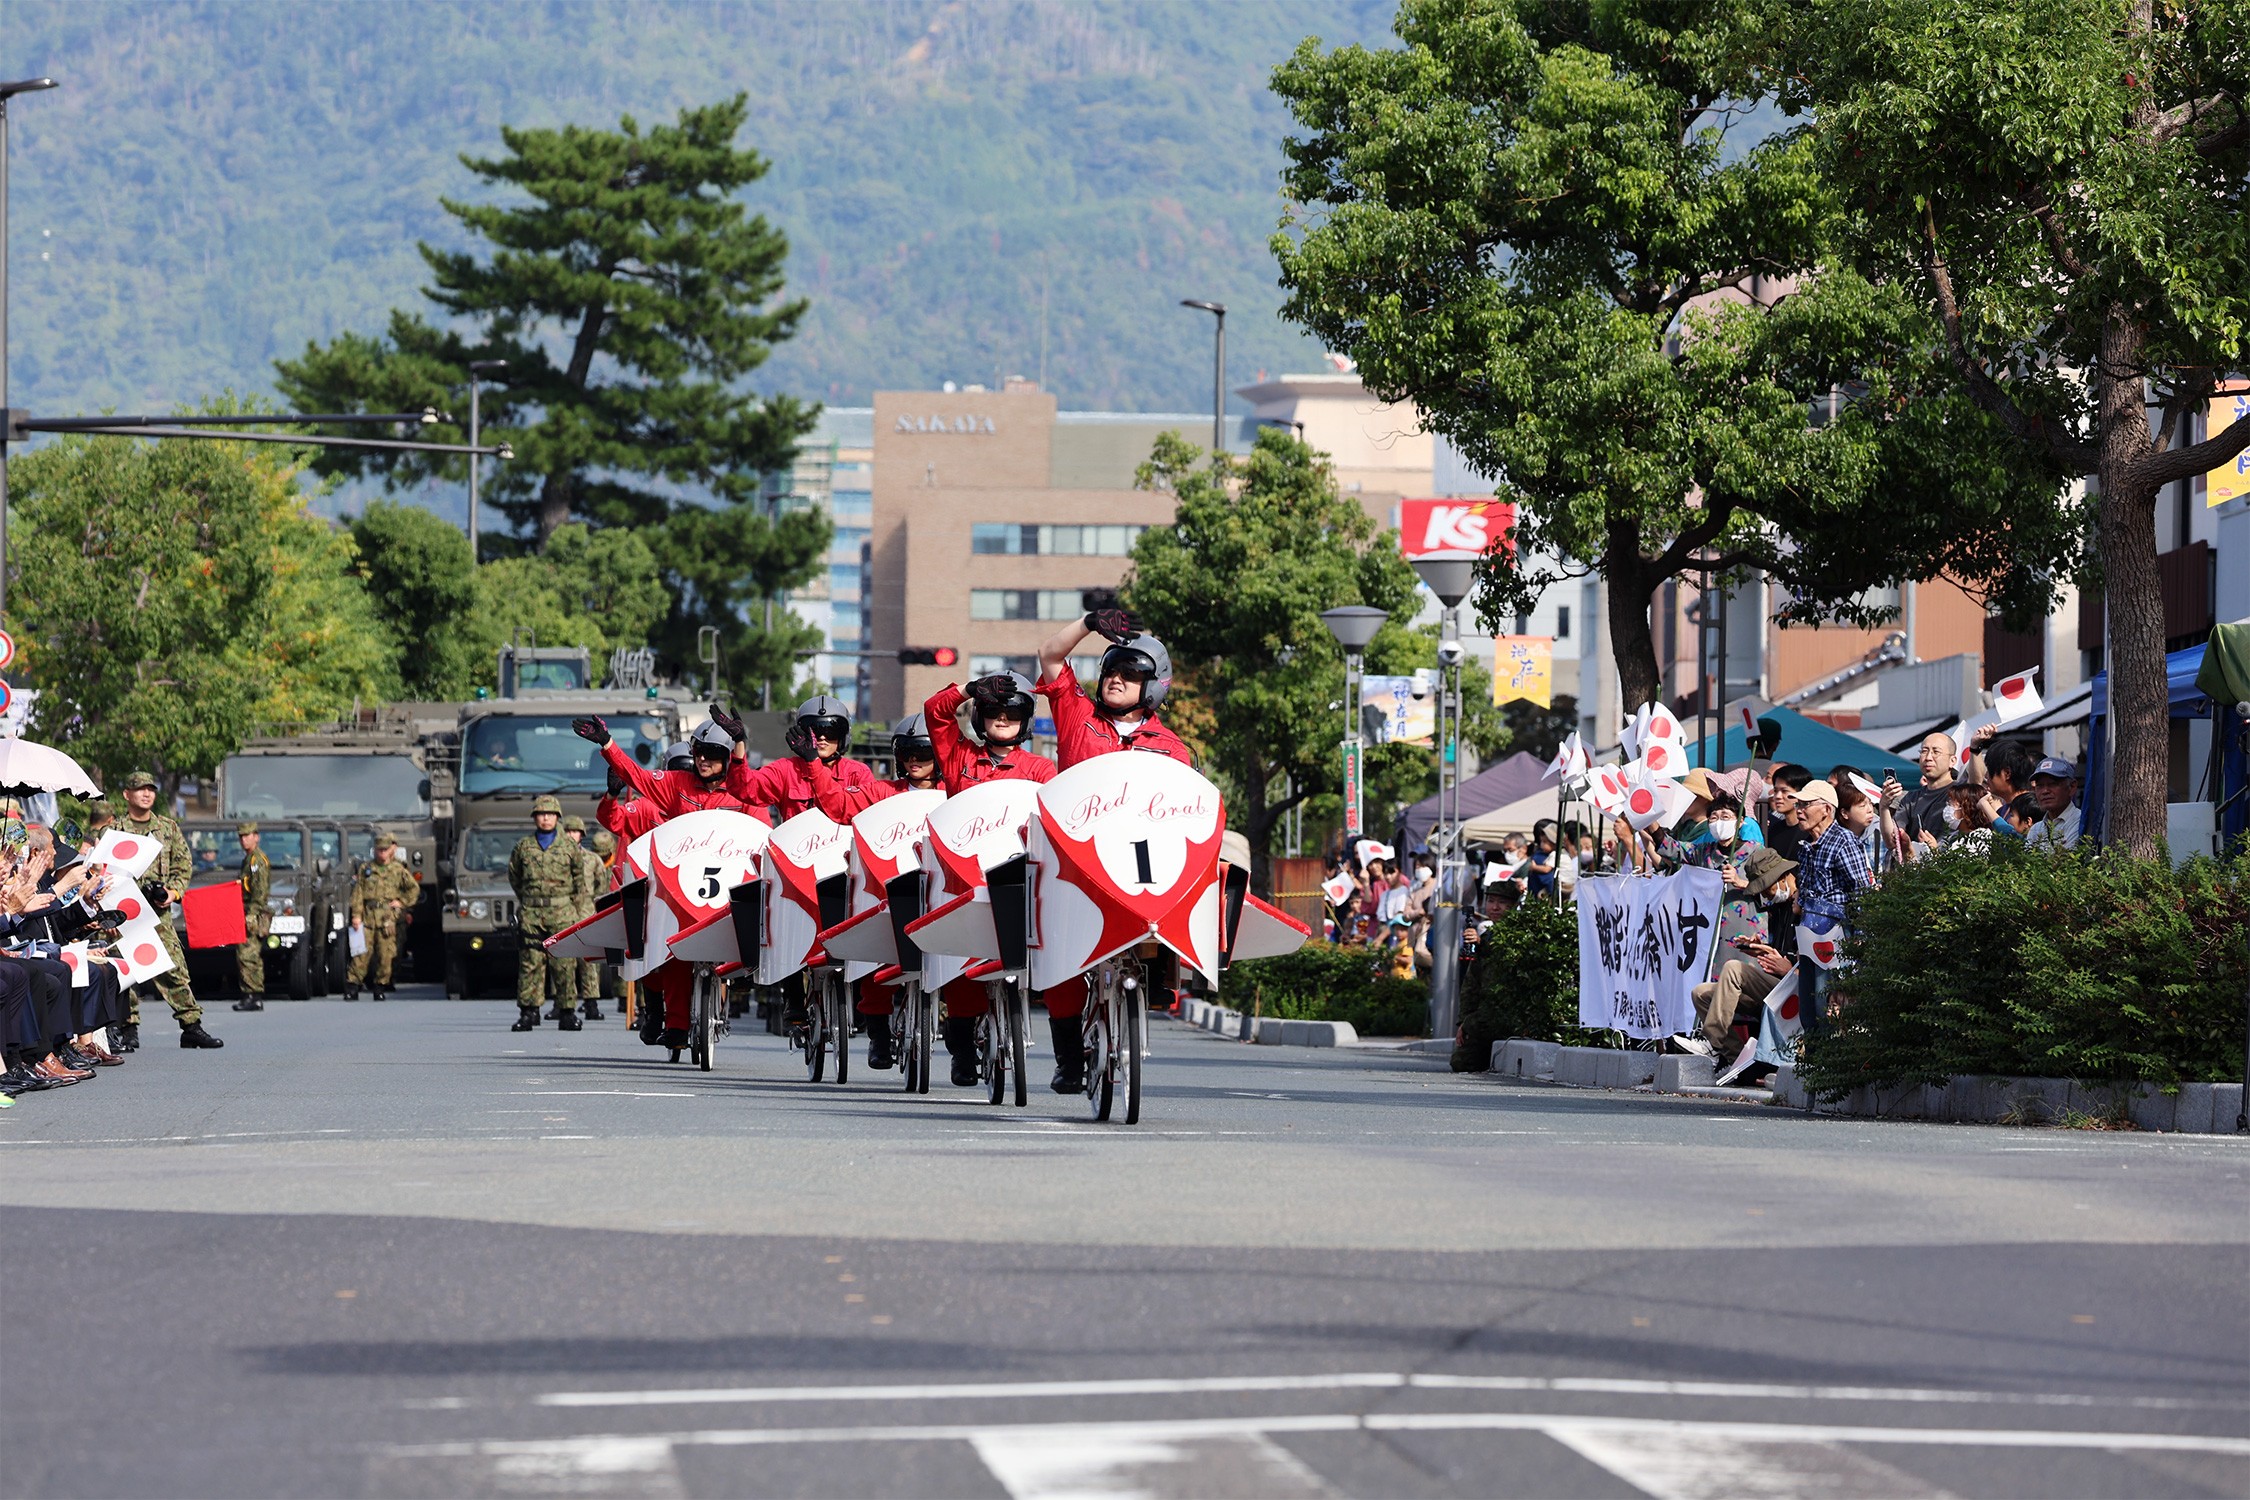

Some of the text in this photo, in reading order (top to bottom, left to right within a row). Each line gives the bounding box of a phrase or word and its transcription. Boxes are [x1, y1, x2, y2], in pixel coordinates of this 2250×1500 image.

[894, 413, 996, 434] SAKAYA
[1393, 684, 1410, 738] 神在月
[1069, 782, 1207, 831] Red Crab
[795, 824, 842, 860] Red
[878, 813, 928, 849] Red
[956, 805, 1010, 848] Red
[666, 830, 715, 860] Red
[1129, 838, 1158, 885] 1
[698, 866, 722, 899] 5
